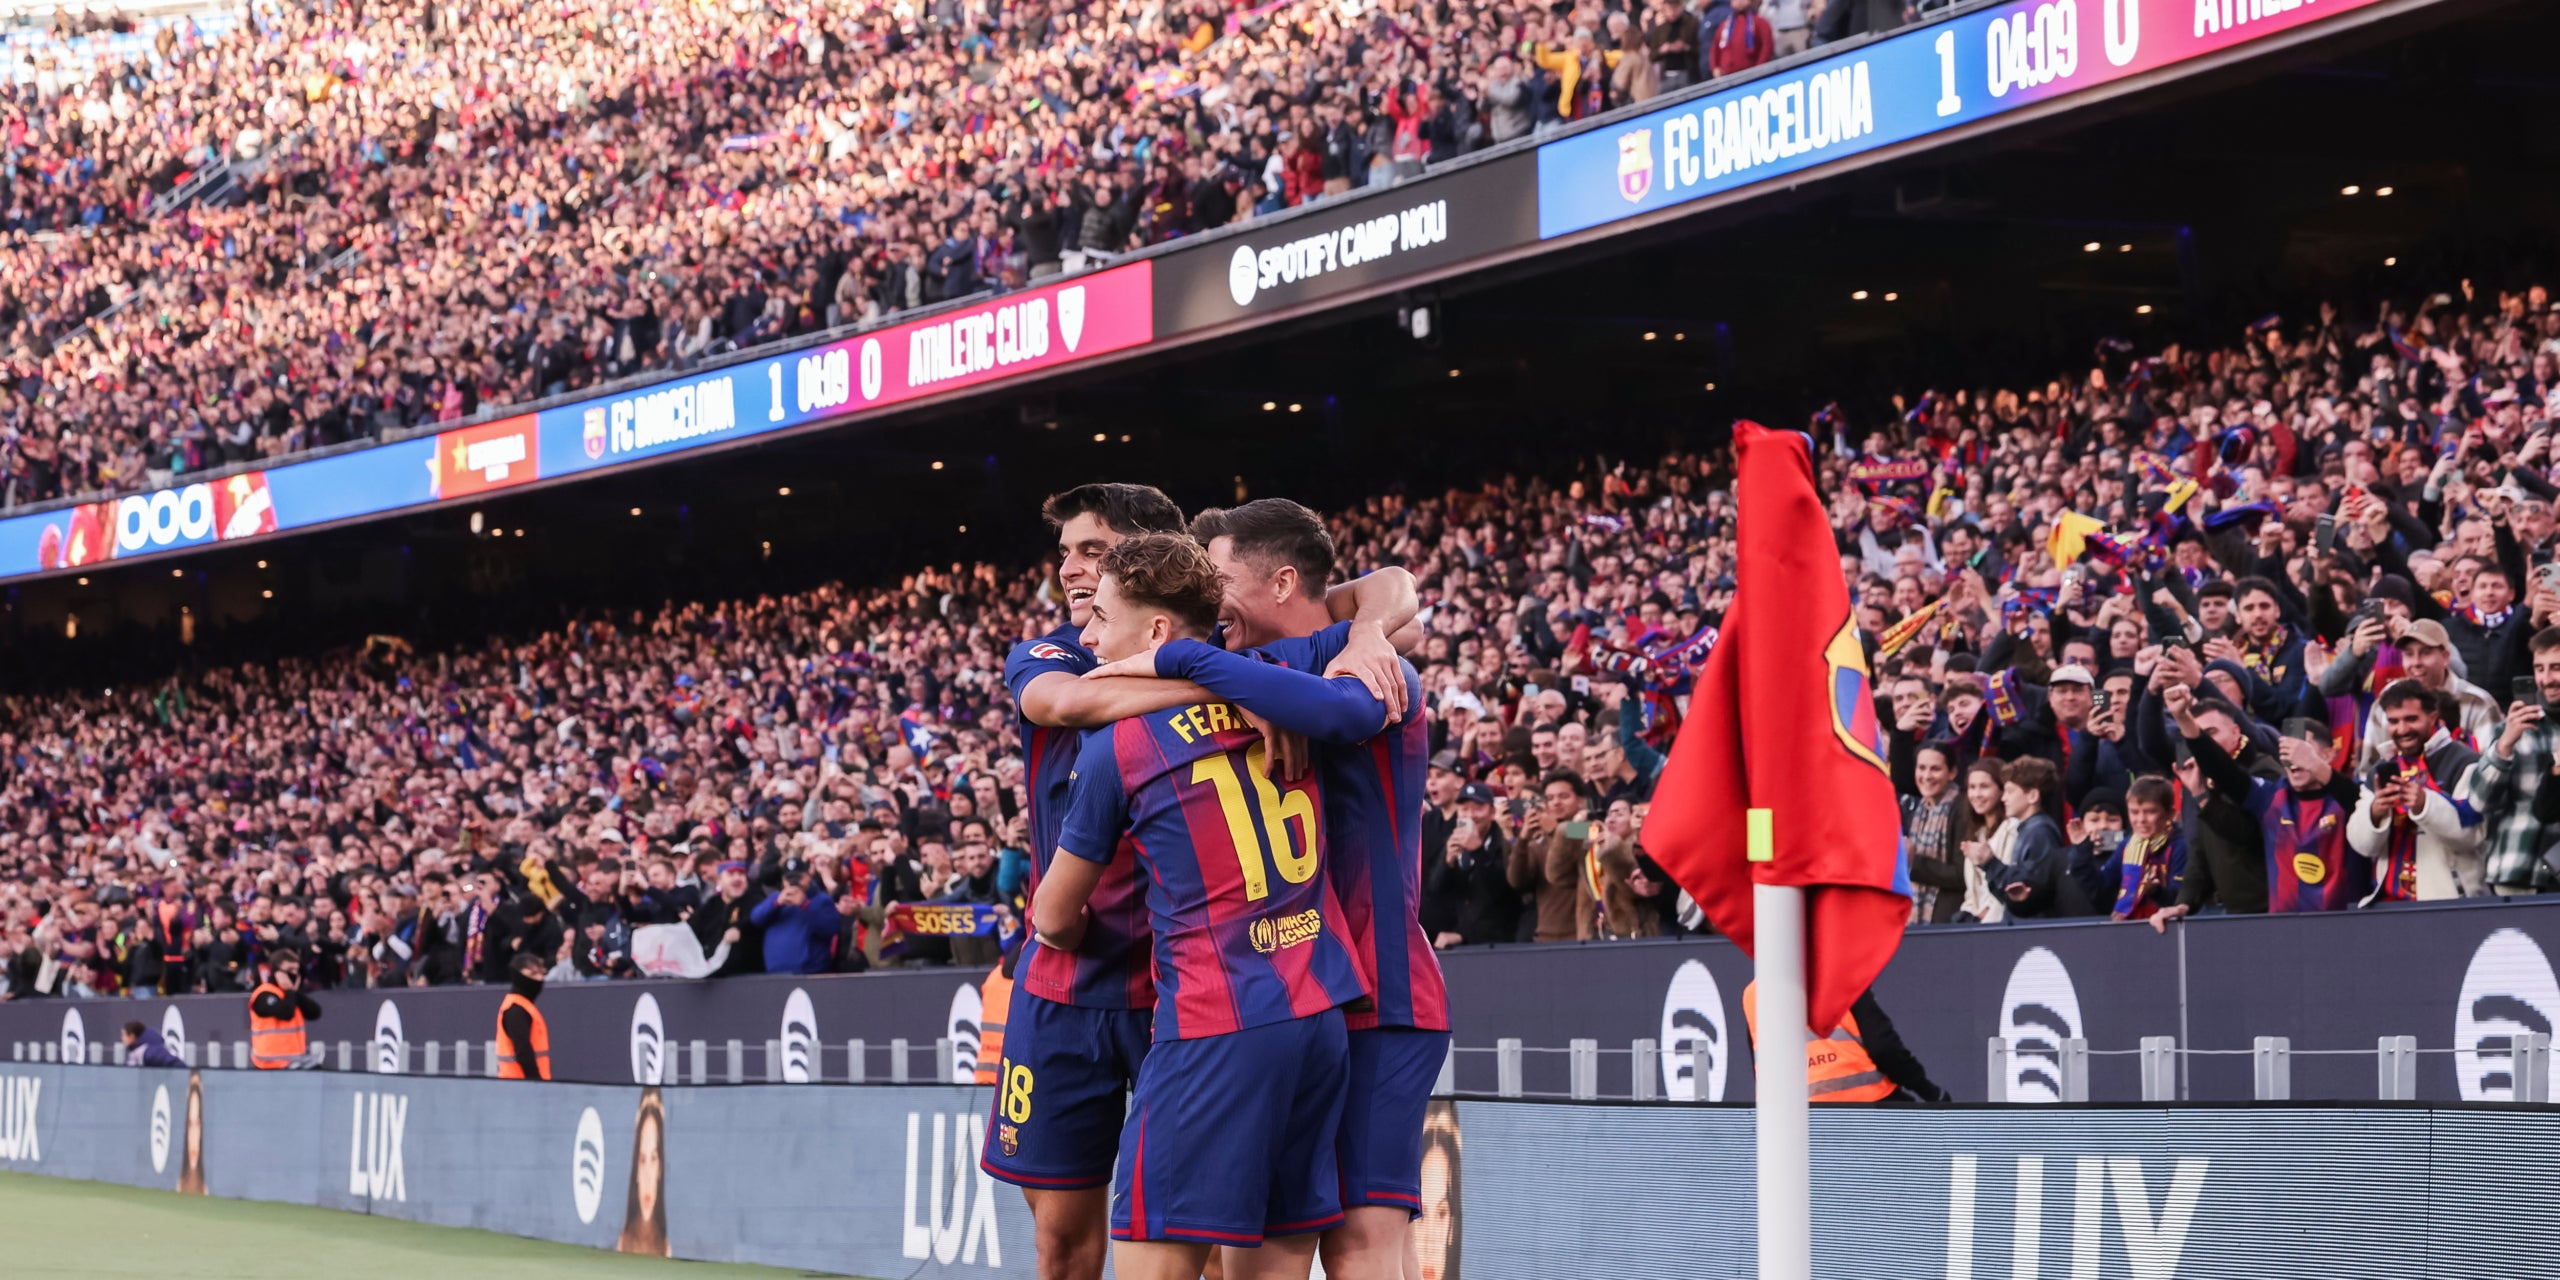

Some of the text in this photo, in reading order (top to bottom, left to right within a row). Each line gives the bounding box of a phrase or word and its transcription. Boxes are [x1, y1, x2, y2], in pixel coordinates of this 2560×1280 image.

[1935, 30, 1961, 117] 1
[1986, 0, 2078, 97] 04:09
[2104, 0, 2139, 66] 0
[1664, 61, 1873, 190] FC BARCELONA
[1258, 200, 1446, 289] SPOTIFY CAMP NOU
[860, 338, 882, 400] 0
[908, 298, 1049, 387] ATHLETIC CLUB
[611, 376, 735, 453] FC BARCELONA
[768, 362, 785, 422] 1
[1191, 740, 1318, 902] 16
[914, 913, 976, 934] SOSES
[1277, 909, 1320, 931] UNHCR
[1000, 1057, 1034, 1123] 18
[350, 1091, 408, 1202] LUX
[903, 1112, 1002, 1268] LUX
